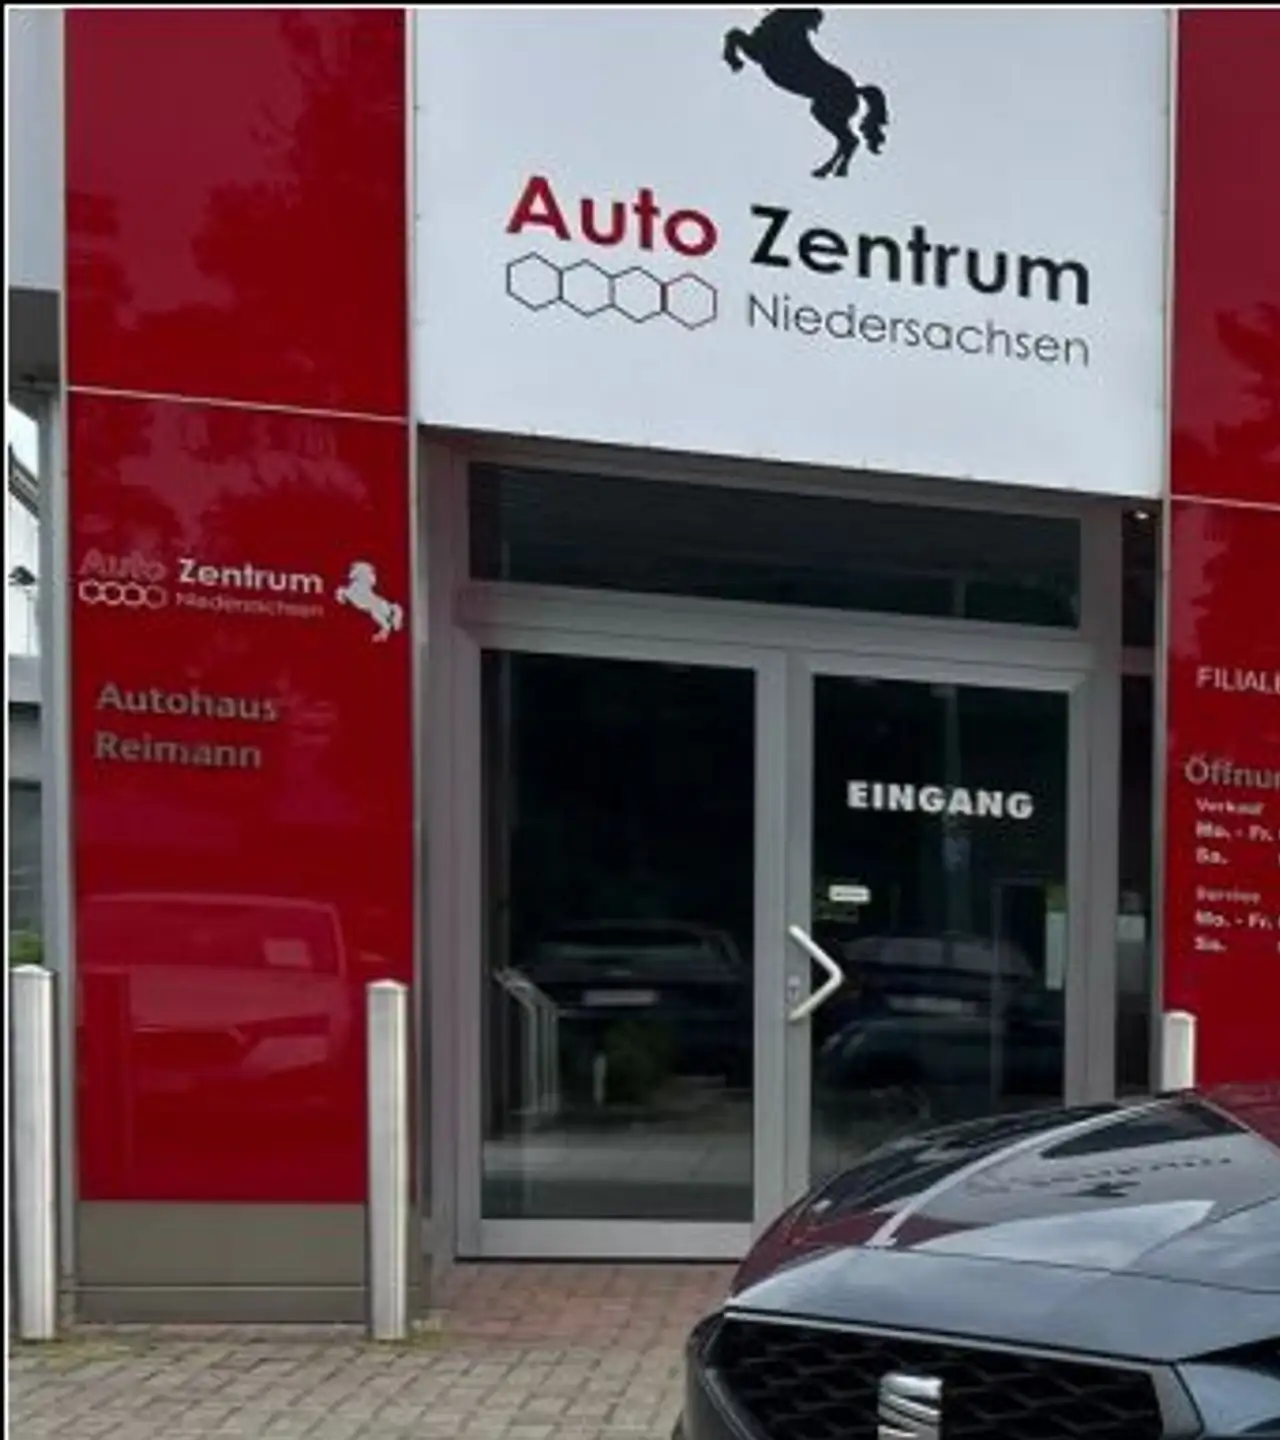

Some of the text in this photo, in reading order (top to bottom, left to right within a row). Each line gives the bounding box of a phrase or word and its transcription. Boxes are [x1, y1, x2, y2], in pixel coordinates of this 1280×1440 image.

[506, 174, 1091, 306] Auto Zentrum
[747, 293, 1090, 367] Niedersachsen
[78, 548, 325, 595] Auto Zentrum
[96, 681, 280, 723] Autohaus
[94, 729, 262, 769] Reimann
[846, 779, 1034, 820] EINGANG
